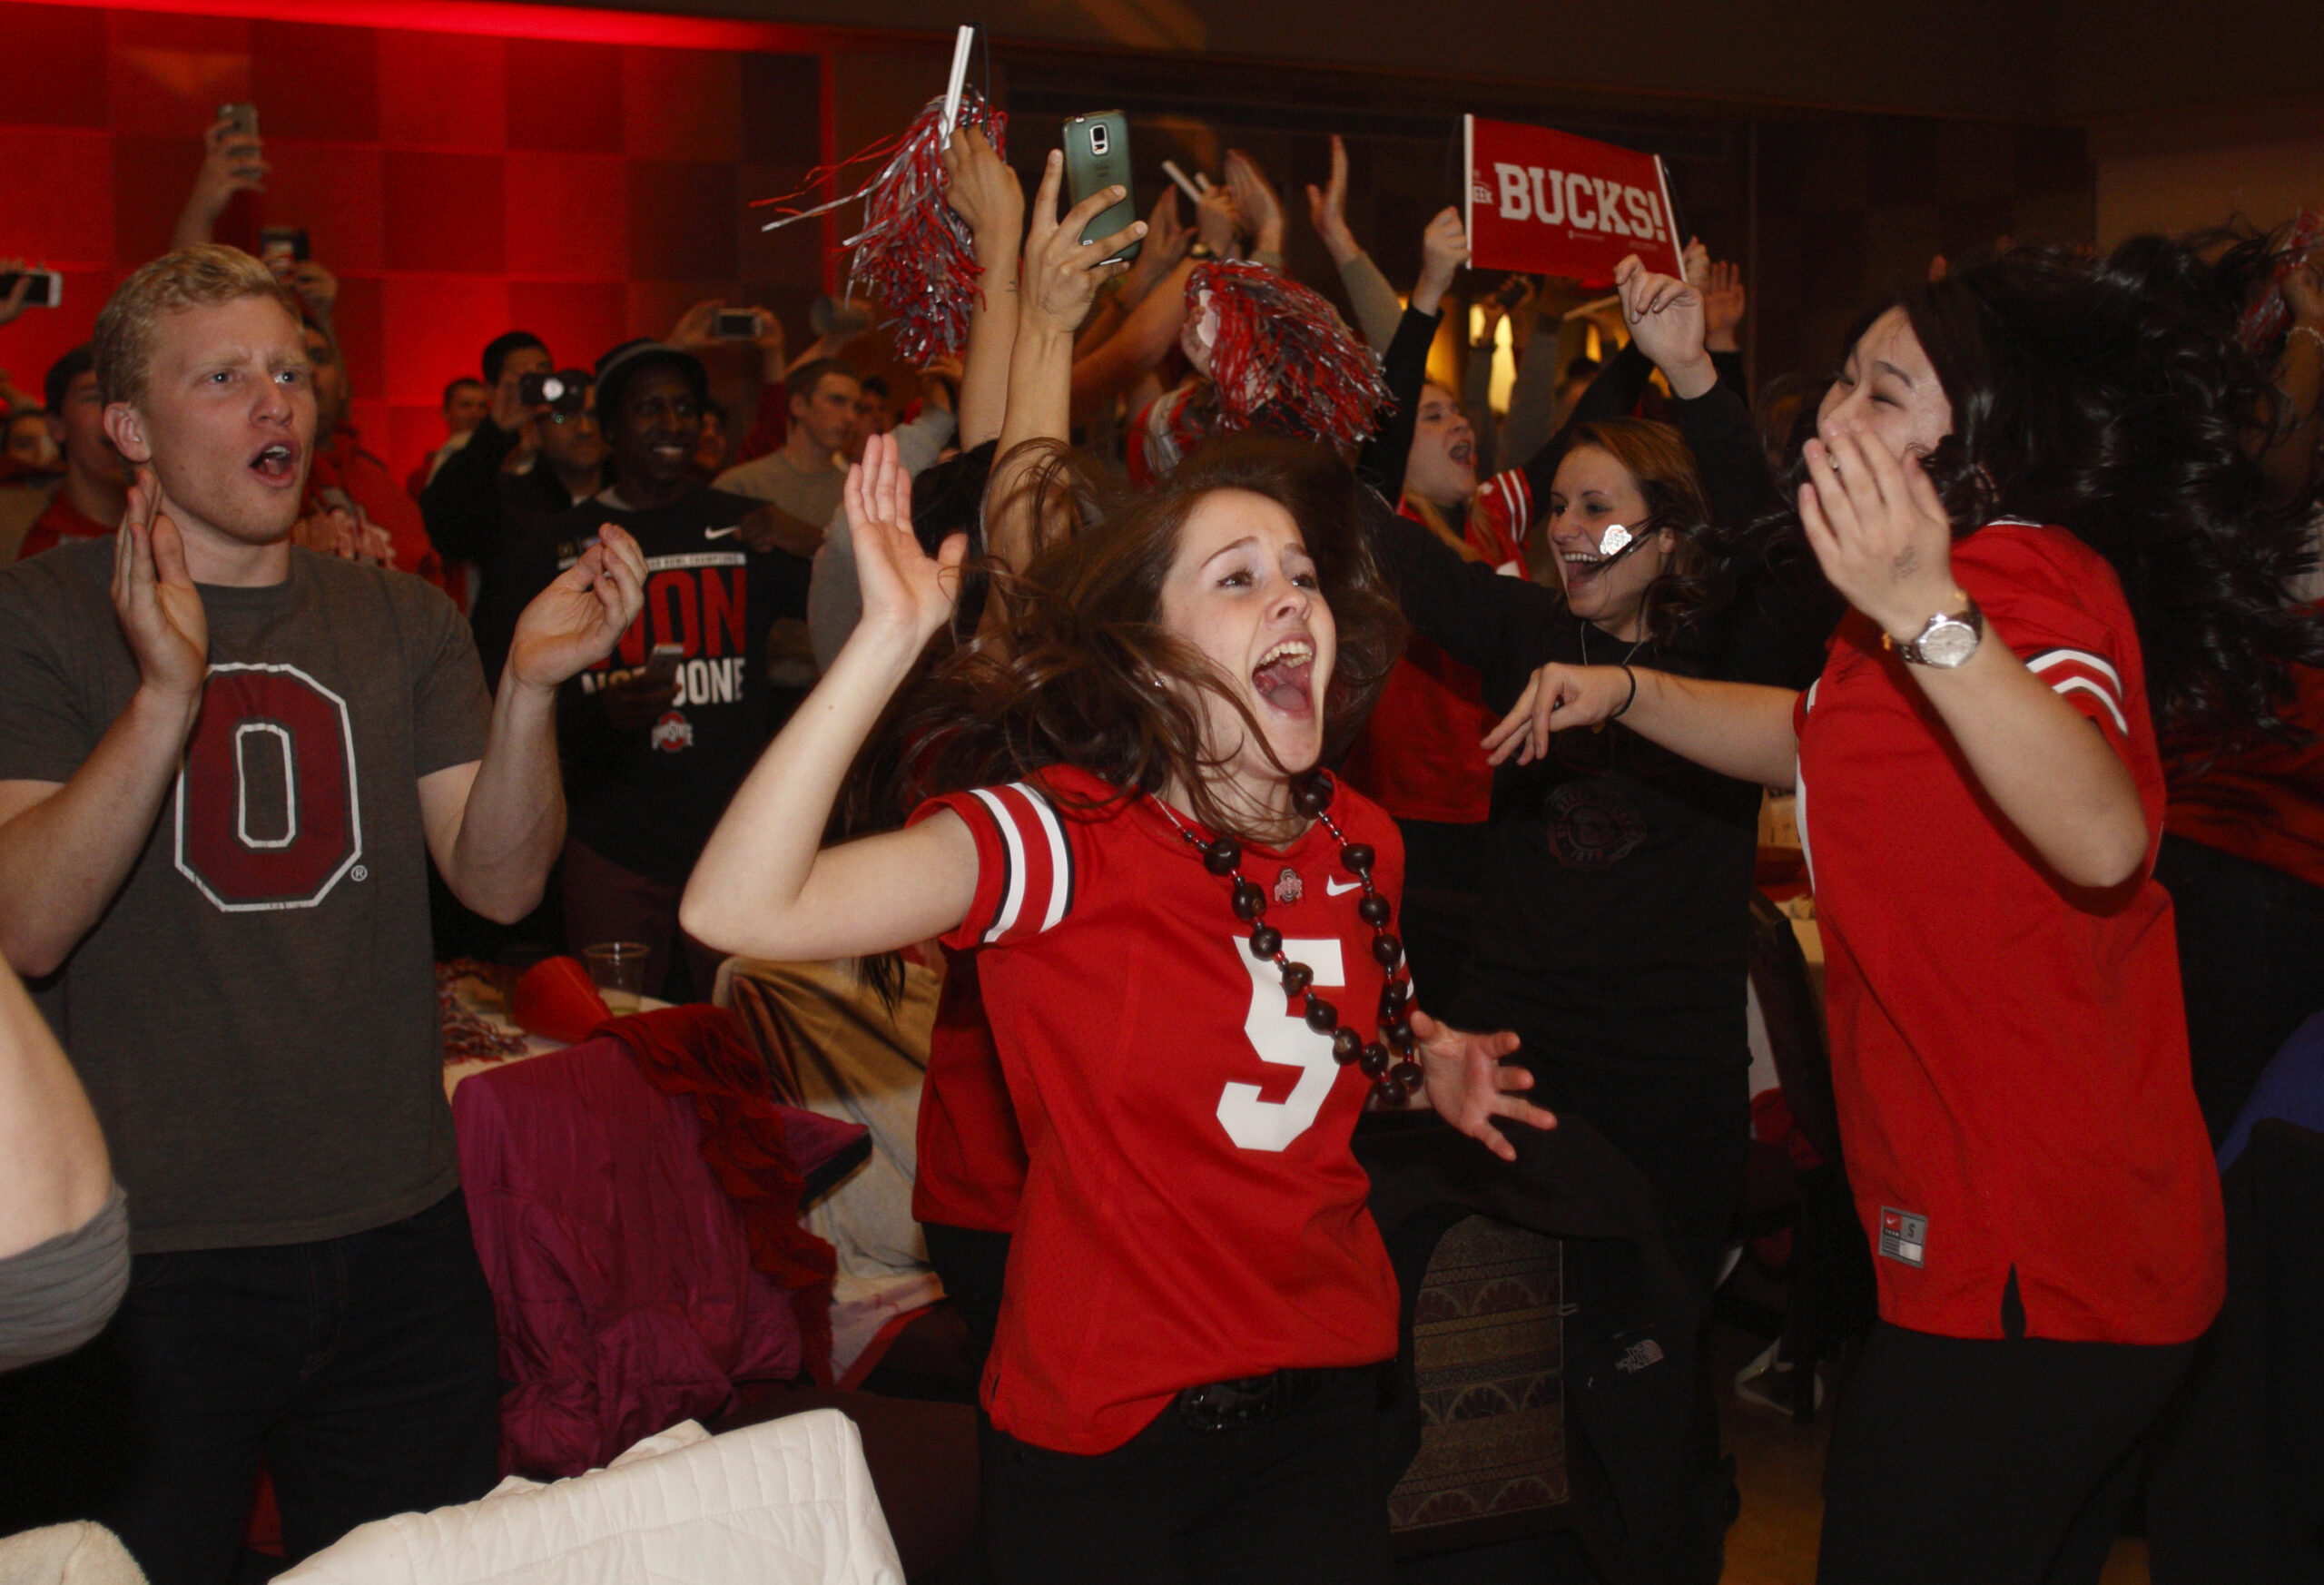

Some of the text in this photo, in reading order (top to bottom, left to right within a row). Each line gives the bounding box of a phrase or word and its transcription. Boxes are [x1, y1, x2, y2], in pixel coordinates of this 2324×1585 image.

[1493, 162, 1667, 242] BUCKS!
[174, 663, 361, 912] O
[1216, 935, 1345, 1152] 5
[1908, 1223, 1915, 1237] S
